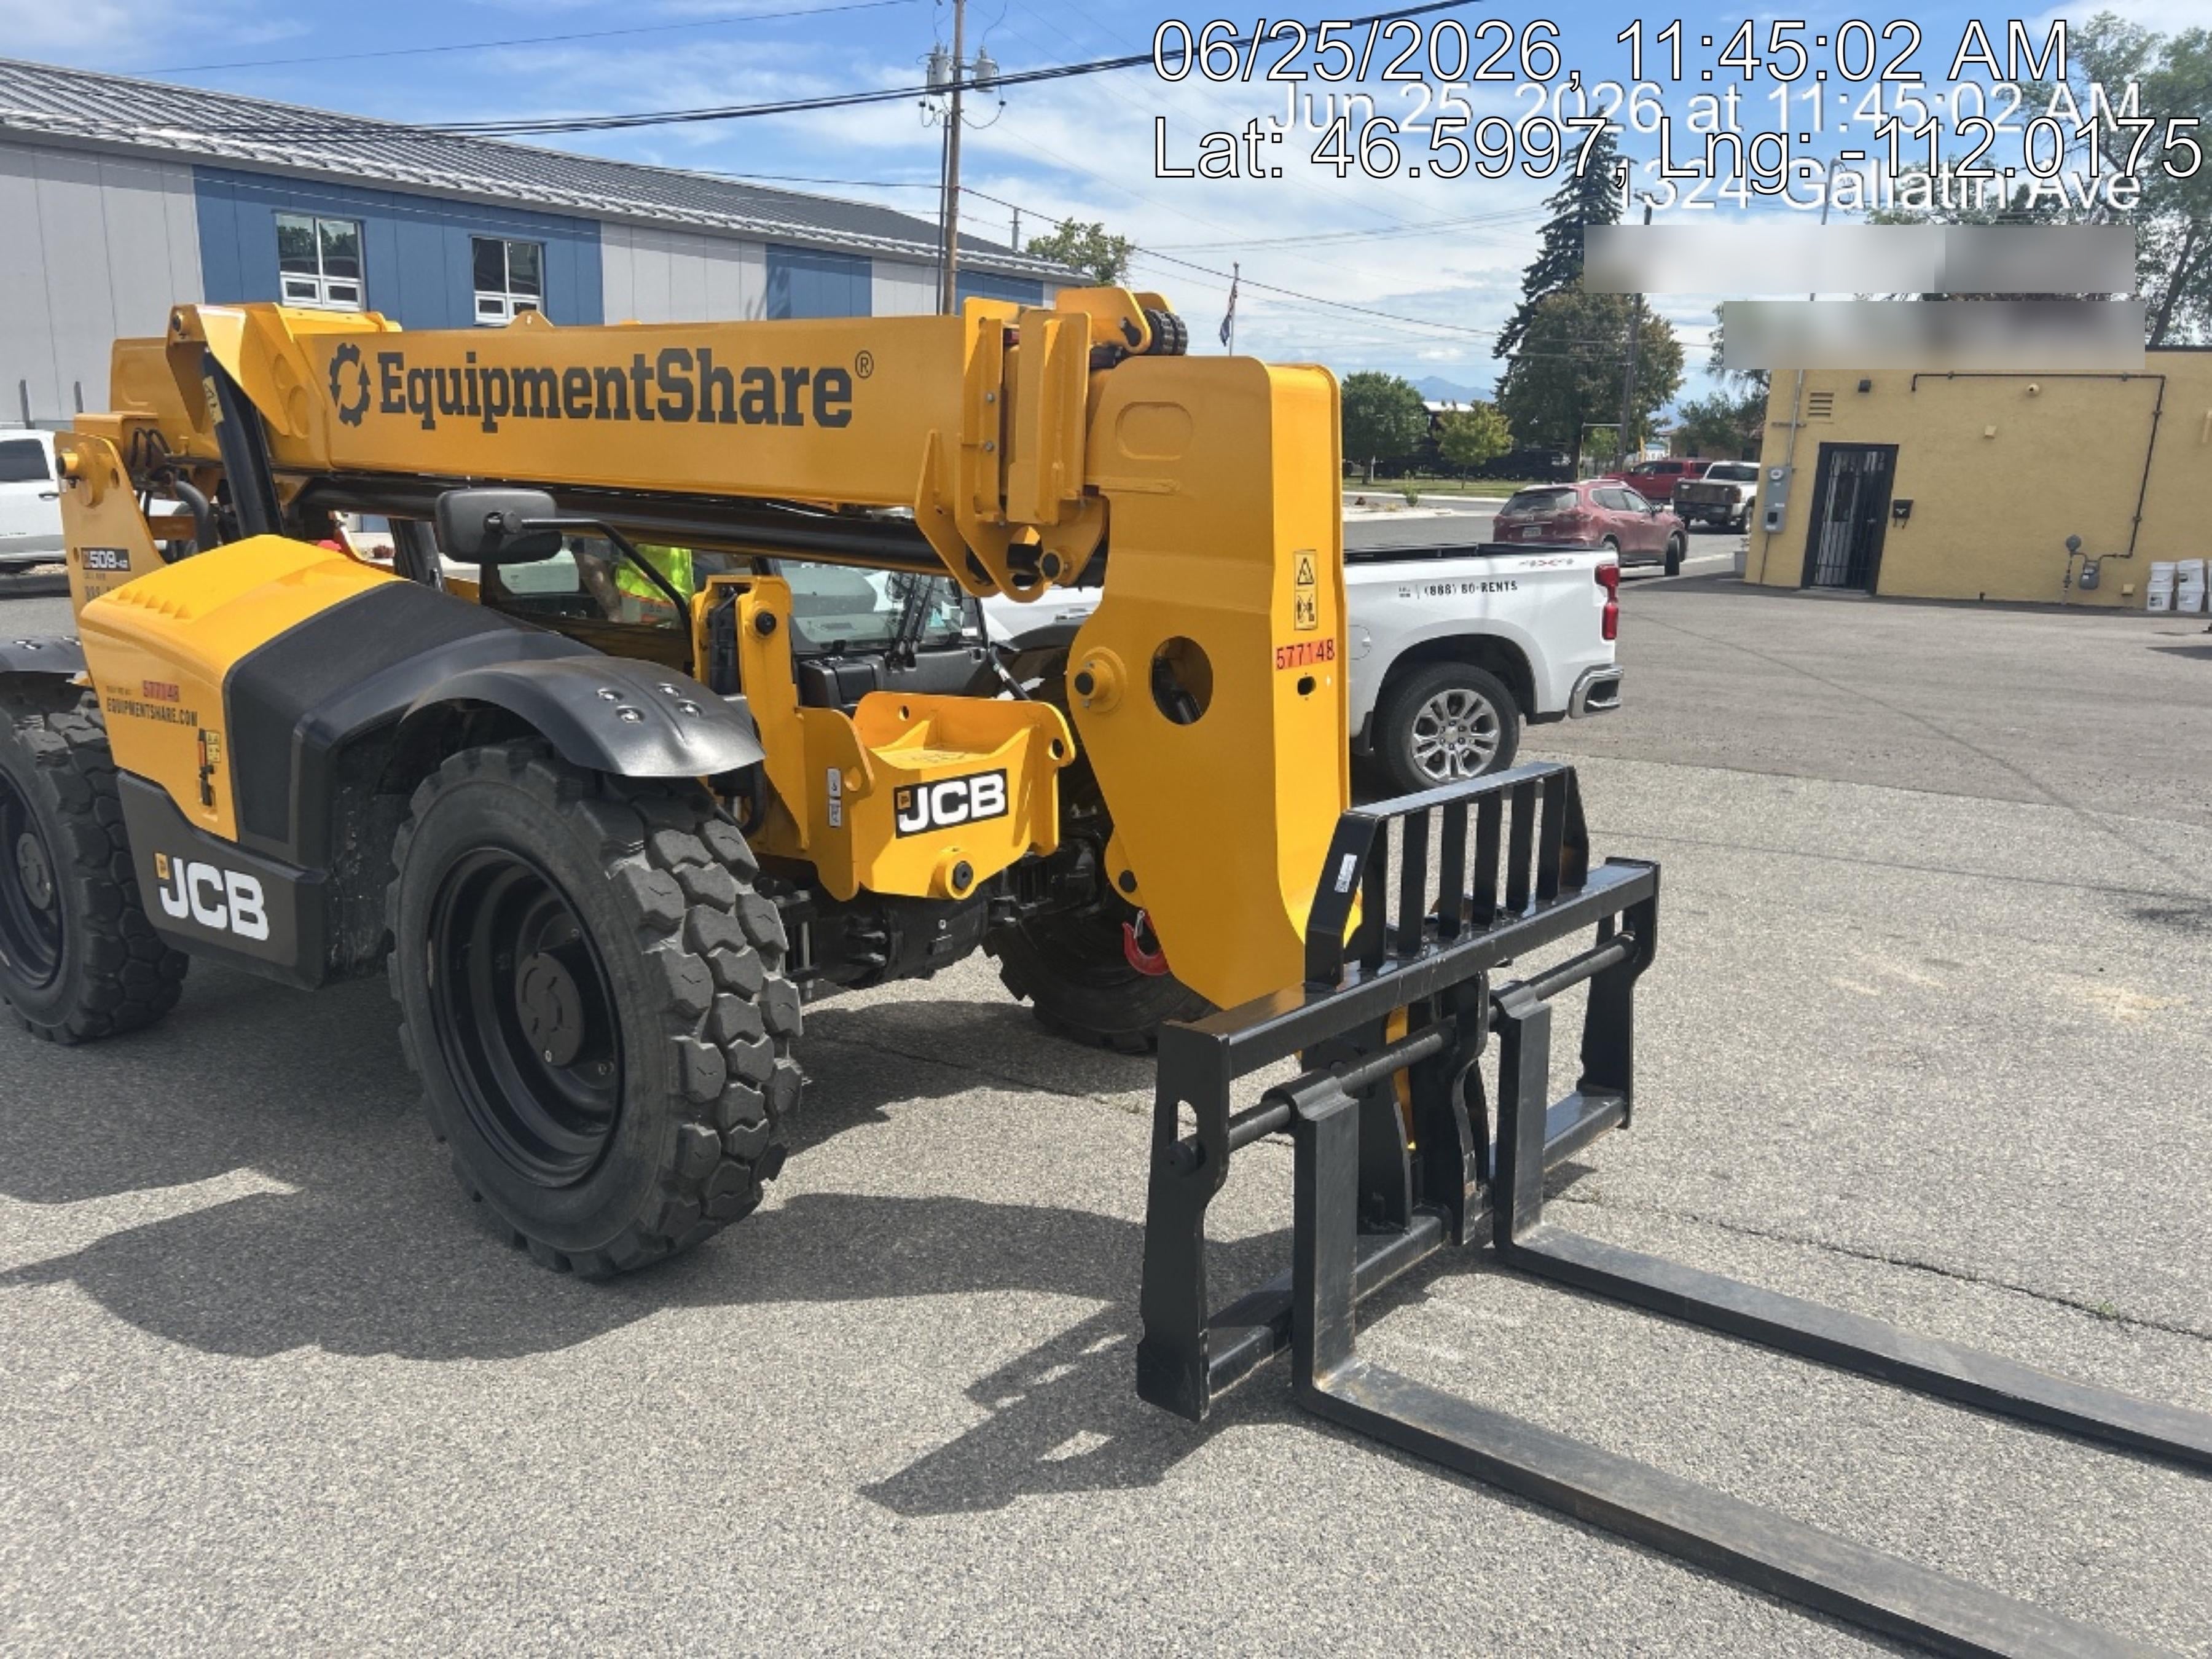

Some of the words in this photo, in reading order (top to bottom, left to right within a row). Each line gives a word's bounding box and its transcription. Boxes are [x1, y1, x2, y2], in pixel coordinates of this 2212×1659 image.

[1276, 638, 1336, 670] 577148
[898, 773, 1006, 833] JCB
[159, 857, 270, 941] JCB
